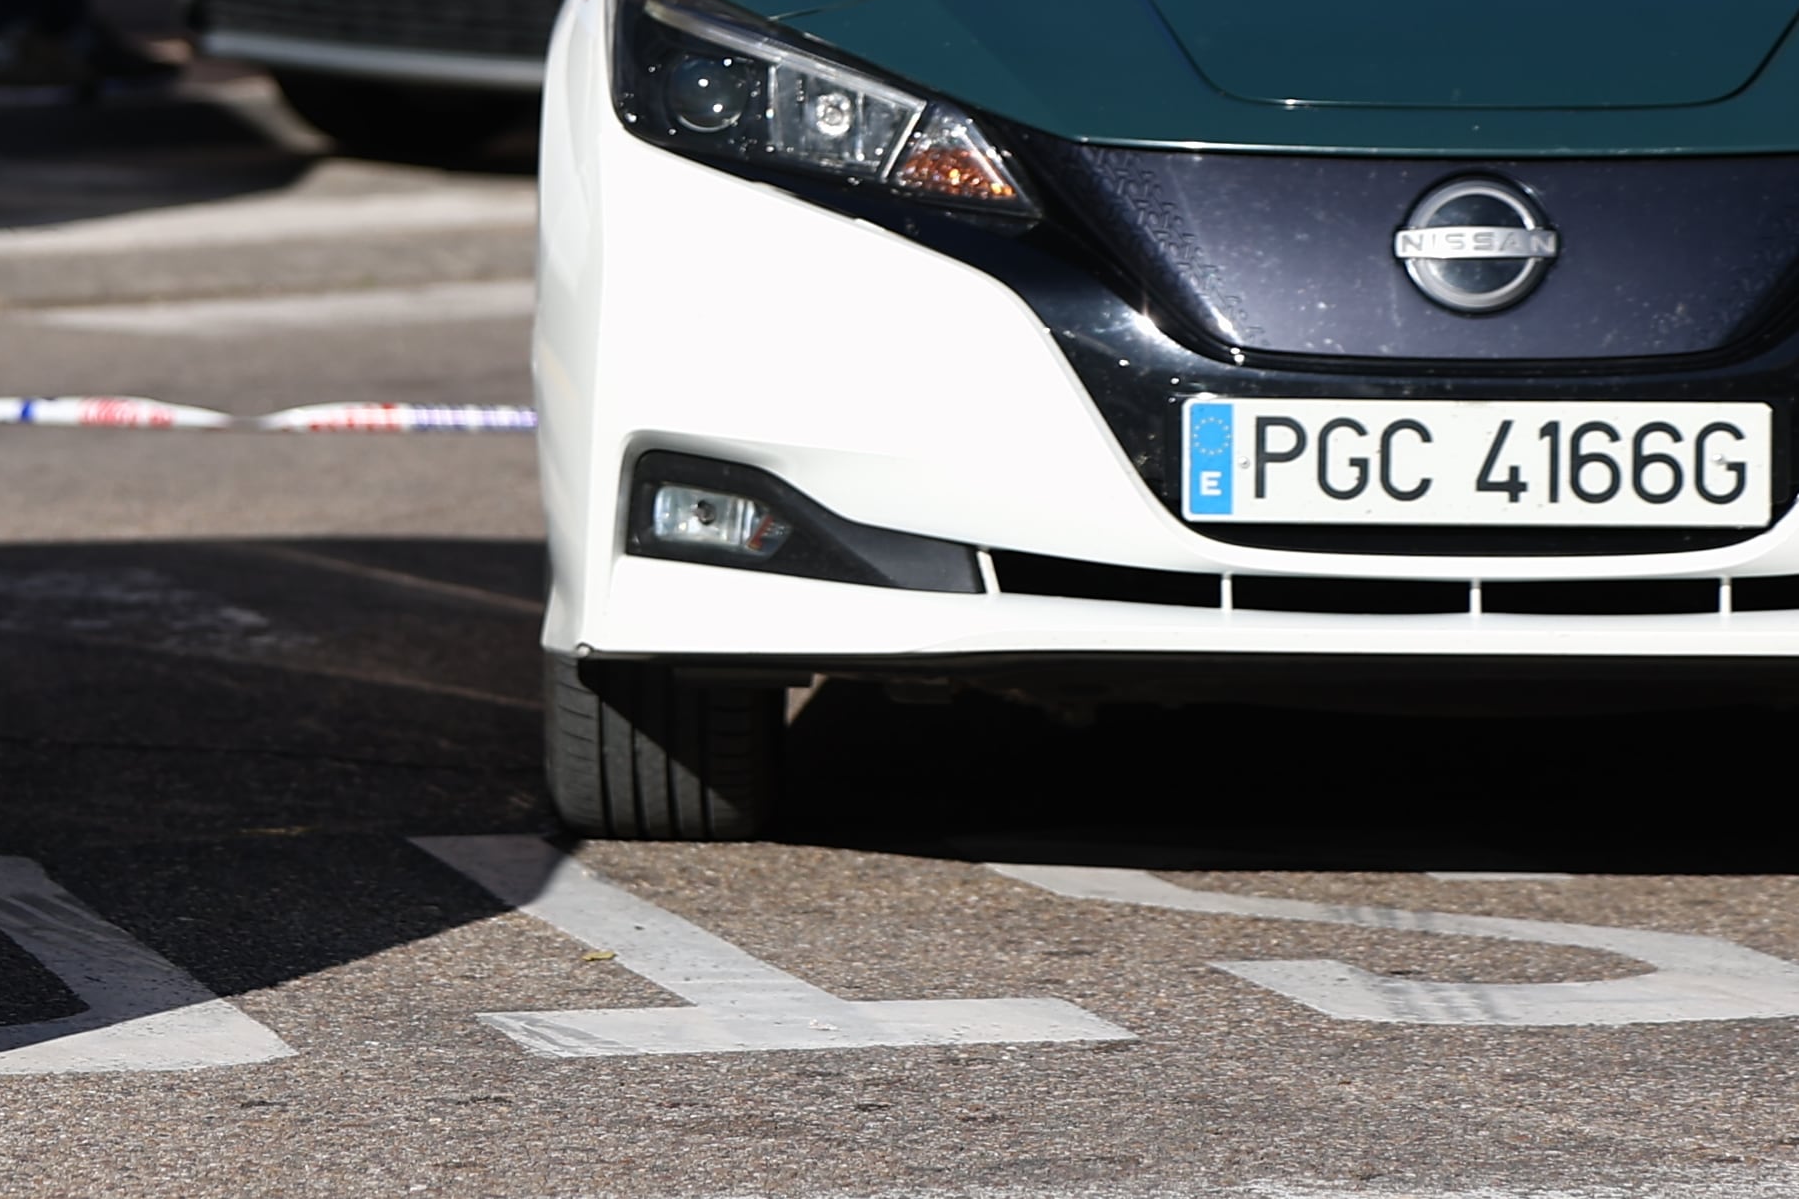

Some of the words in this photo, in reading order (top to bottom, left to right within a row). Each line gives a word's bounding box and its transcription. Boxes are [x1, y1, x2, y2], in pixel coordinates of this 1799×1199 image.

[1401, 231, 1555, 253] NISSAN
[1199, 471, 1222, 497] E
[1254, 415, 1434, 502] PGC
[1474, 419, 1748, 505] 4166G
